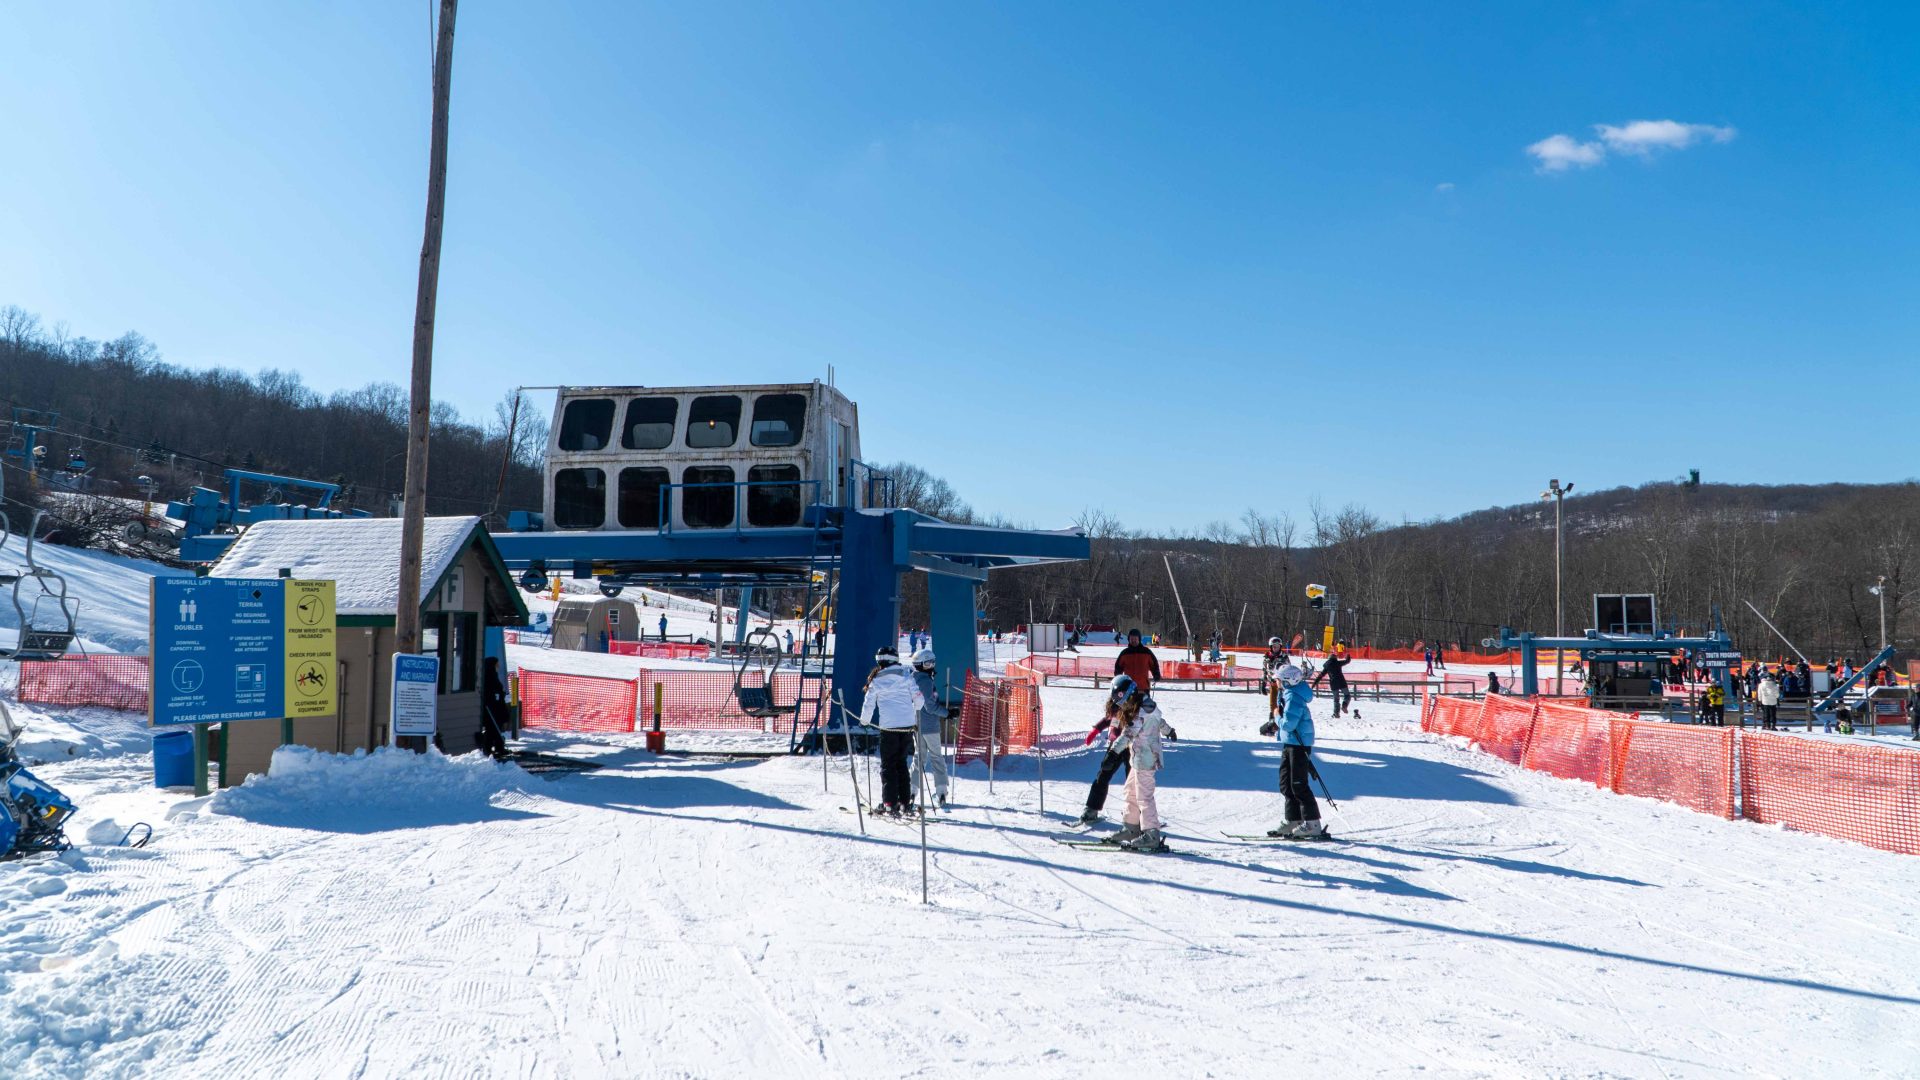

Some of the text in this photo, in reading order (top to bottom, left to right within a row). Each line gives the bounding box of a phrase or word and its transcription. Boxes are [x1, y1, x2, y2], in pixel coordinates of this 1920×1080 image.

[448, 574, 458, 603] F
[402, 659, 435, 670] INSTRUCTIONS
[400, 671, 435, 682] AND WARNINGS
